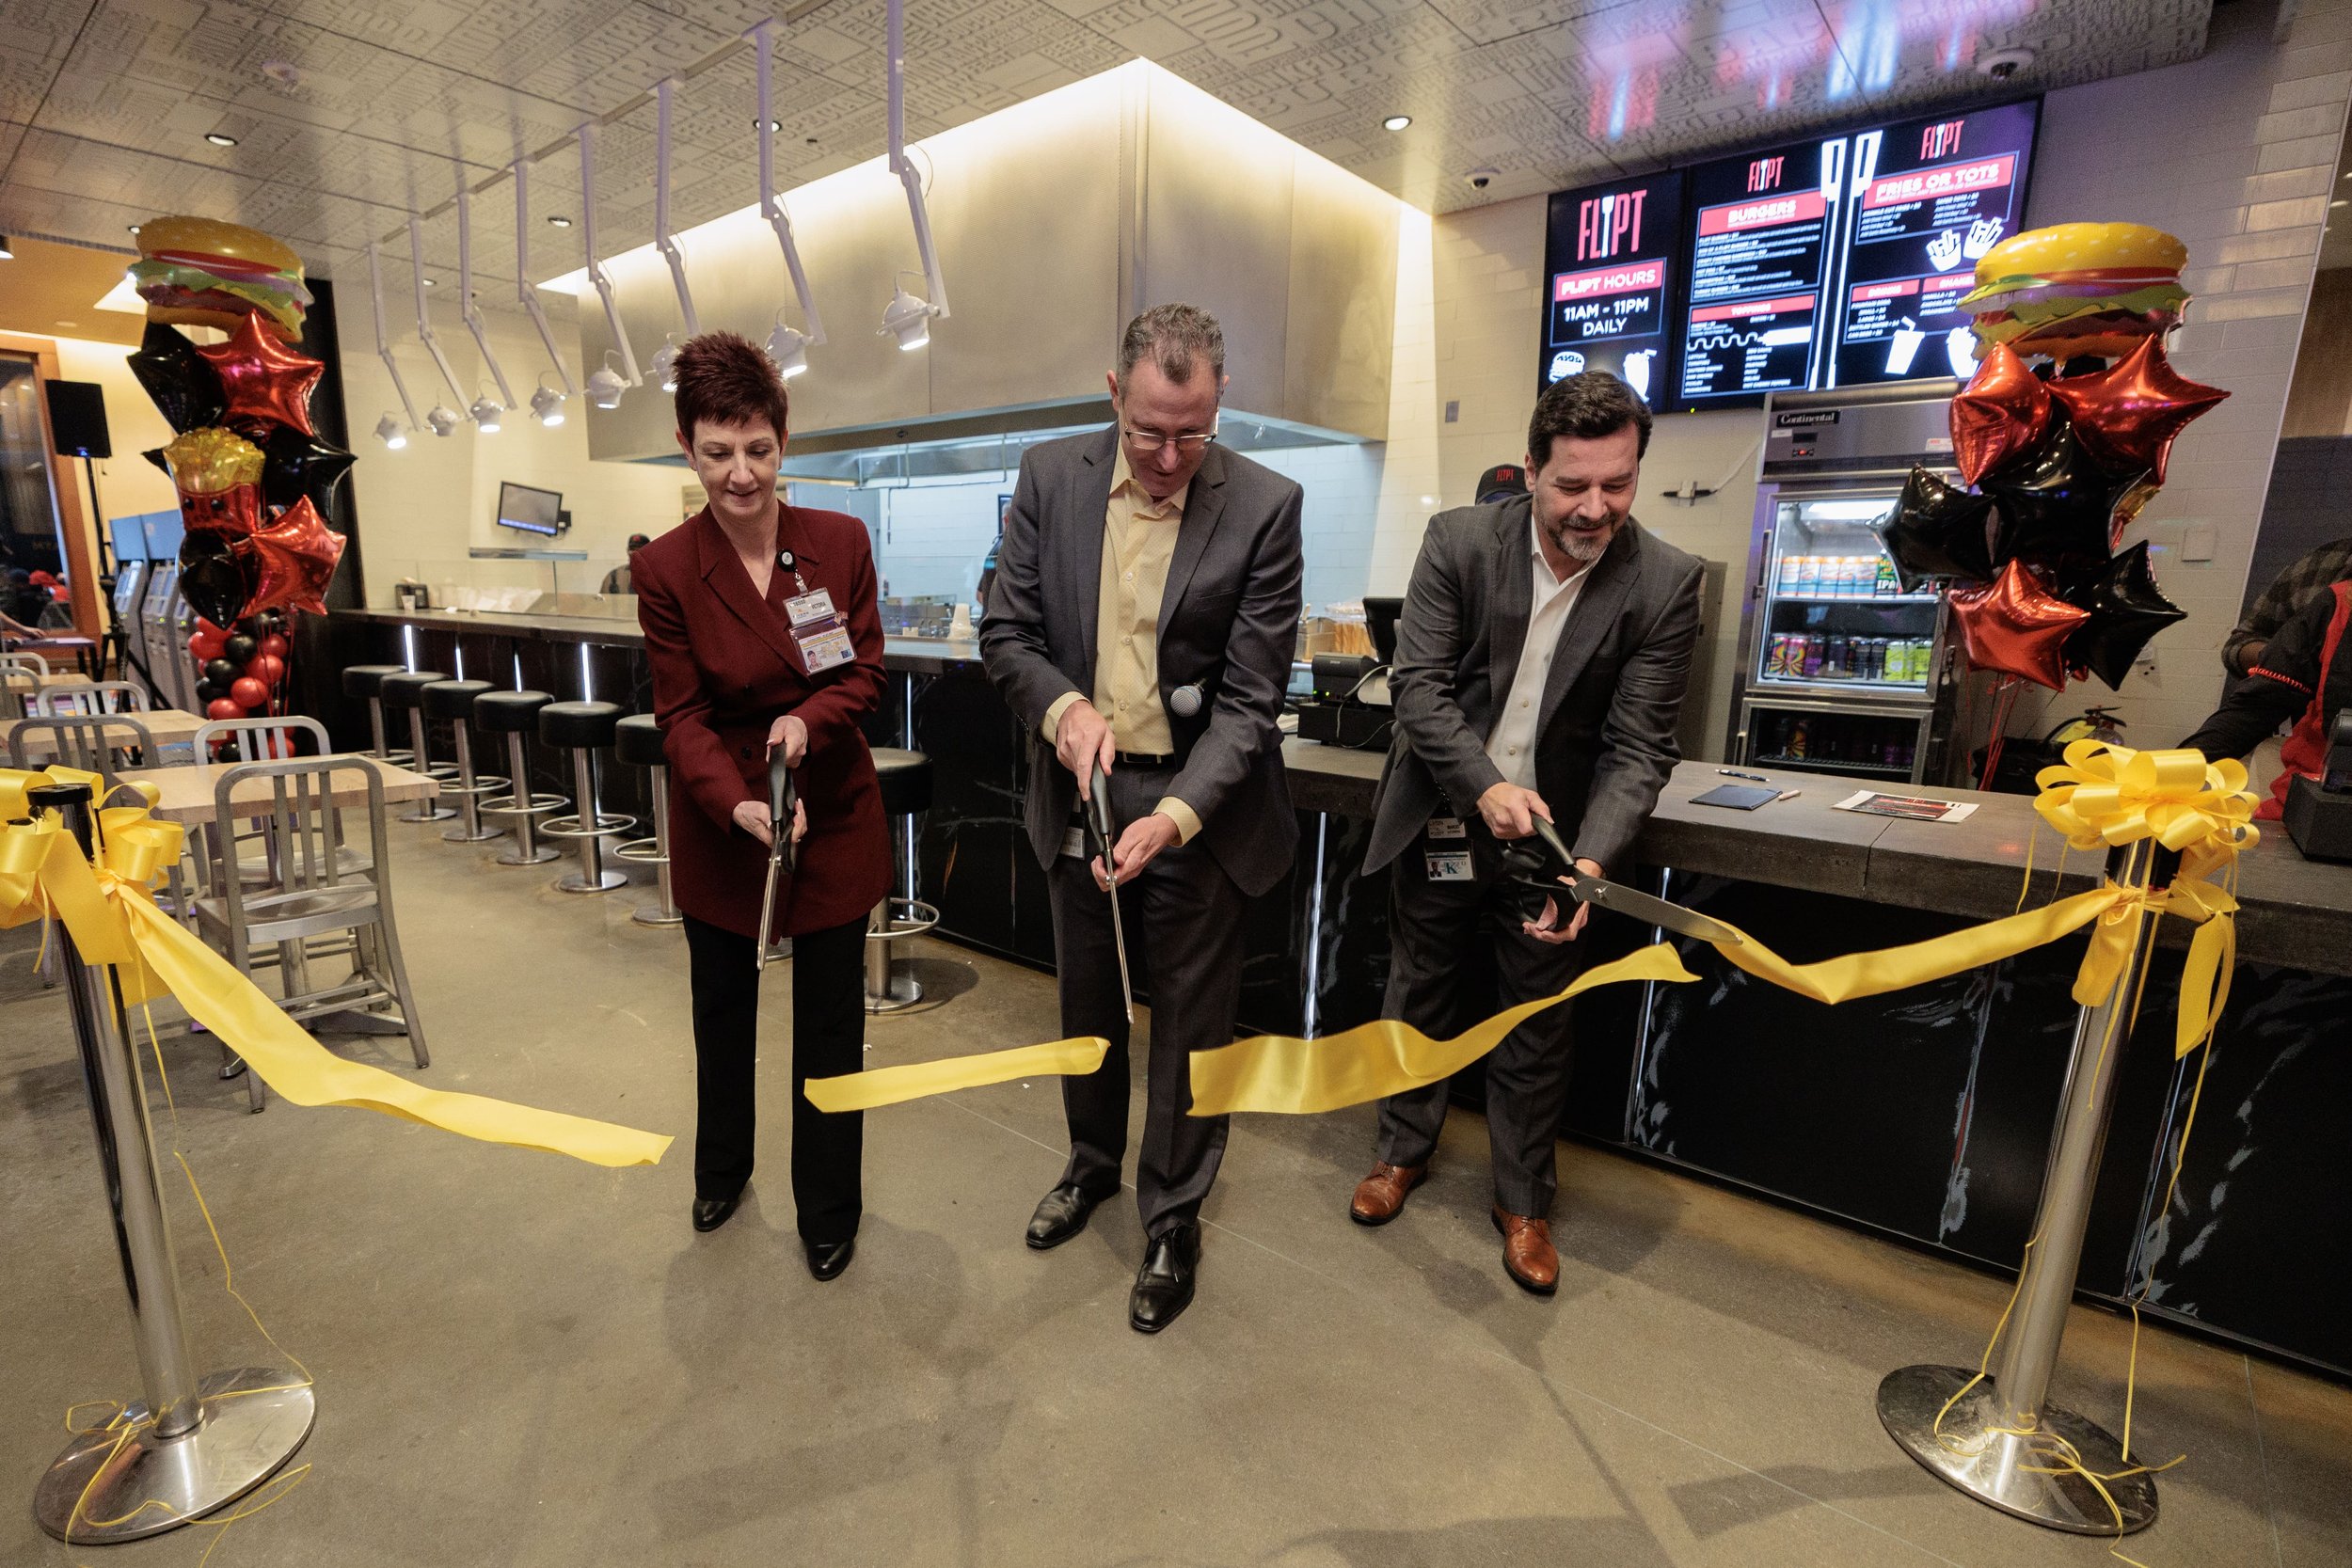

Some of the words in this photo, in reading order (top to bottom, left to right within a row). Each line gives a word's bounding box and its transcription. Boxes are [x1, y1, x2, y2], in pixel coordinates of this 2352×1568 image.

[1876, 177, 1923, 198] FRIES
[1926, 172, 1951, 188] OR
[1955, 164, 1999, 183] TOTS
[1728, 199, 1796, 223] BURGERS
[1578, 189, 1647, 261] FLIPT
[1561, 277, 1601, 295] FLIPT
[1603, 269, 1656, 290] HOURS
[1564, 303, 1599, 322] 11AM
[1613, 296, 1649, 315] 11PM
[1582, 317, 1628, 337] DAILY
[1781, 410, 1835, 423] Continental
[1877, 579, 1896, 590] IPA
